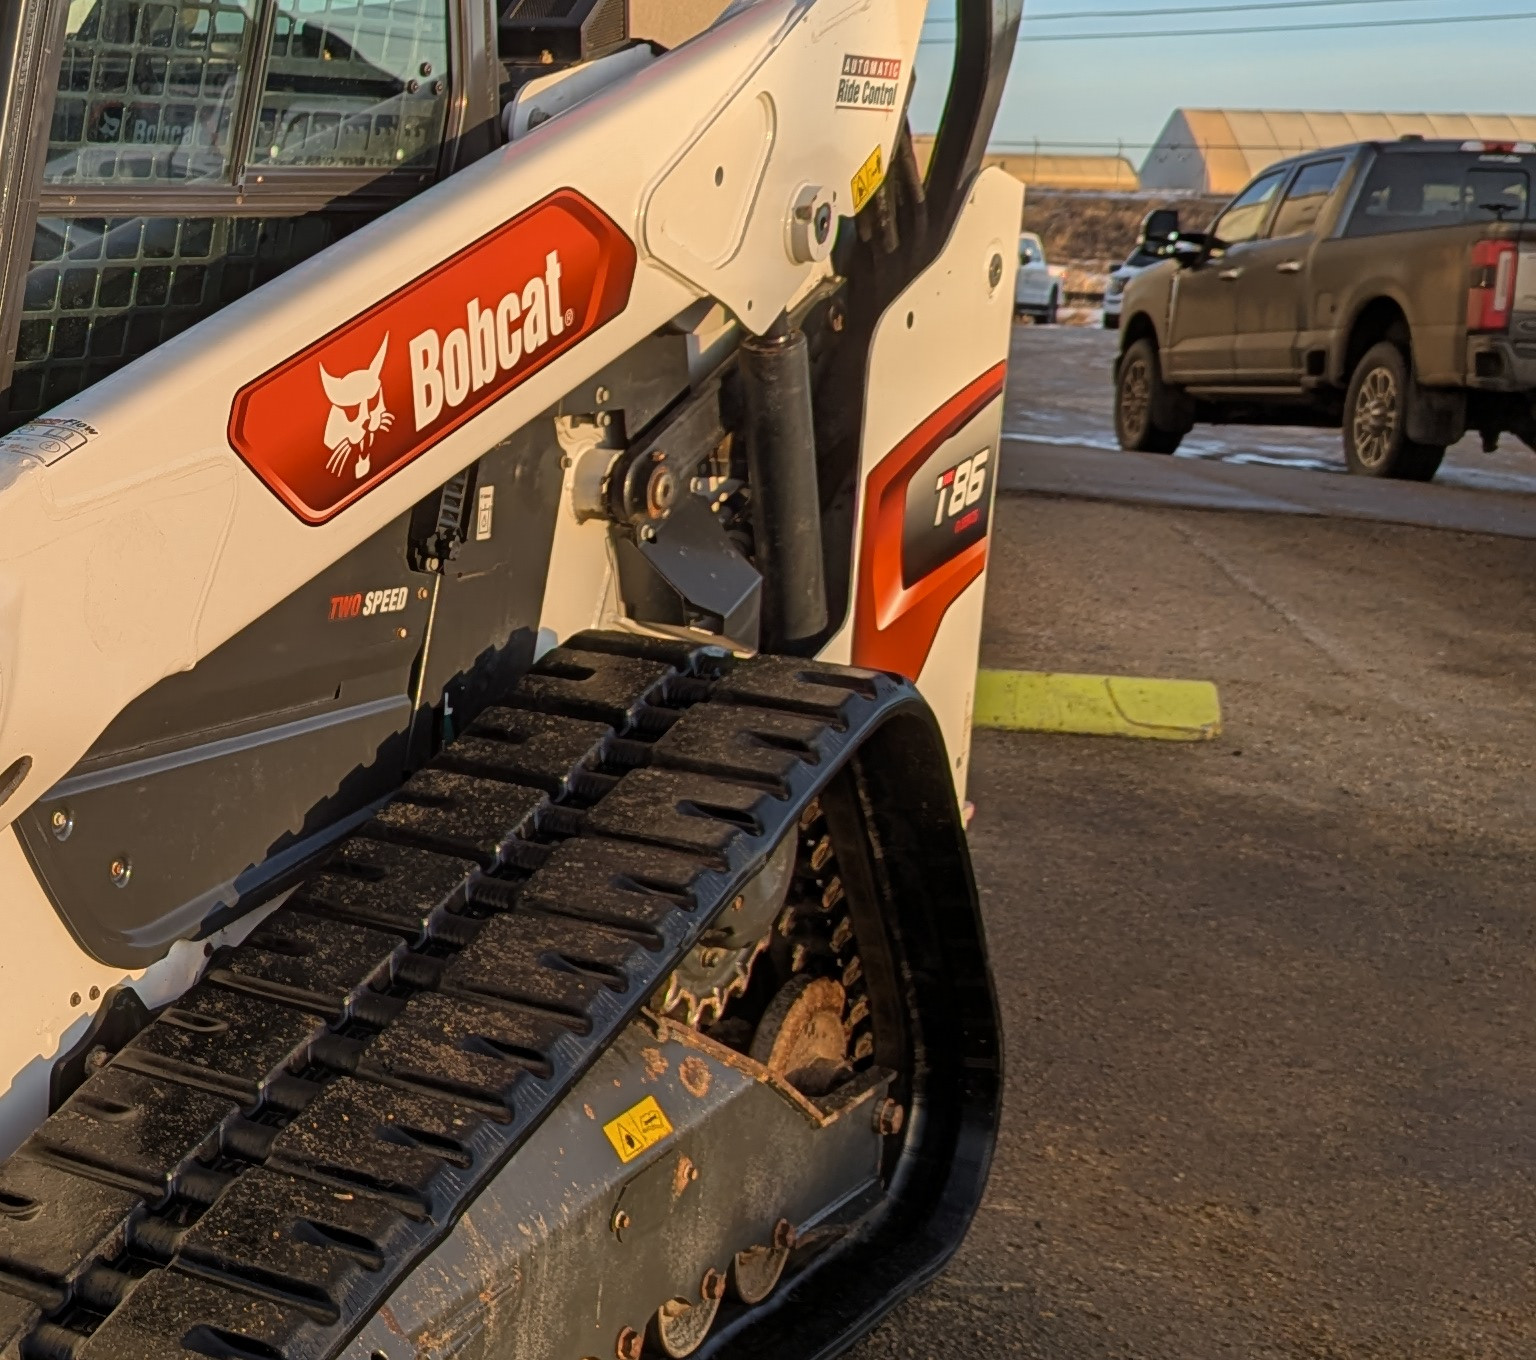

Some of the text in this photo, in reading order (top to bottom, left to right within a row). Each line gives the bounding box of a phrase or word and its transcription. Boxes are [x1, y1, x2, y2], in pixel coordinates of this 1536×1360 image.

[843, 57, 900, 78] AUTOMATIC
[836, 78, 898, 106] Ride Control
[409, 249, 564, 432] Bobcat
[329, 586, 408, 620] TWO SPEED
